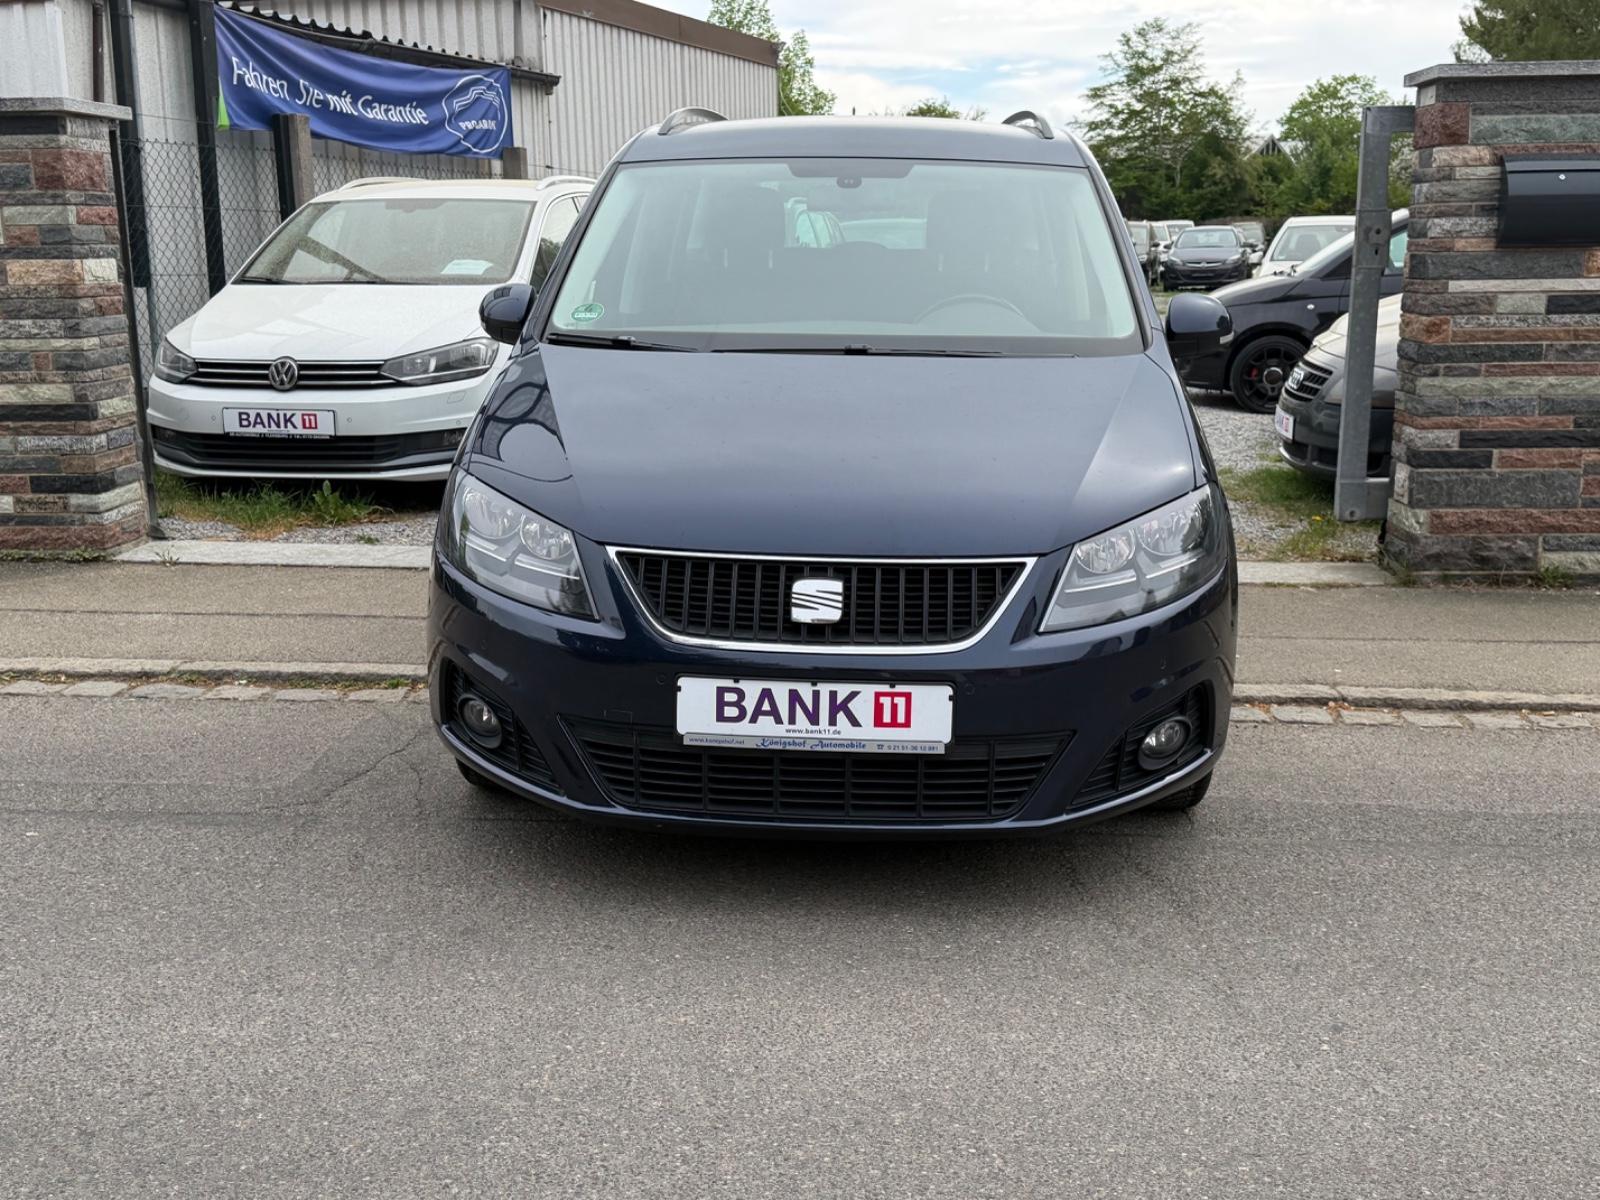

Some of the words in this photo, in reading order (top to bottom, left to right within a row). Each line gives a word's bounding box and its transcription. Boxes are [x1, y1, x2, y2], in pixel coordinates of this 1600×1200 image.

[231, 56, 290, 101] Fahren
[295, 79, 323, 108] Sie
[326, 90, 358, 116] mit
[357, 95, 429, 125] Garantie
[238, 411, 298, 430] BANK
[303, 414, 317, 429] 11
[715, 686, 863, 728] BANK
[879, 696, 906, 724] 11
[785, 728, 842, 736] www.bank11.de
[755, 738, 807, 750] Königshof
[810, 740, 867, 751] Automobile
